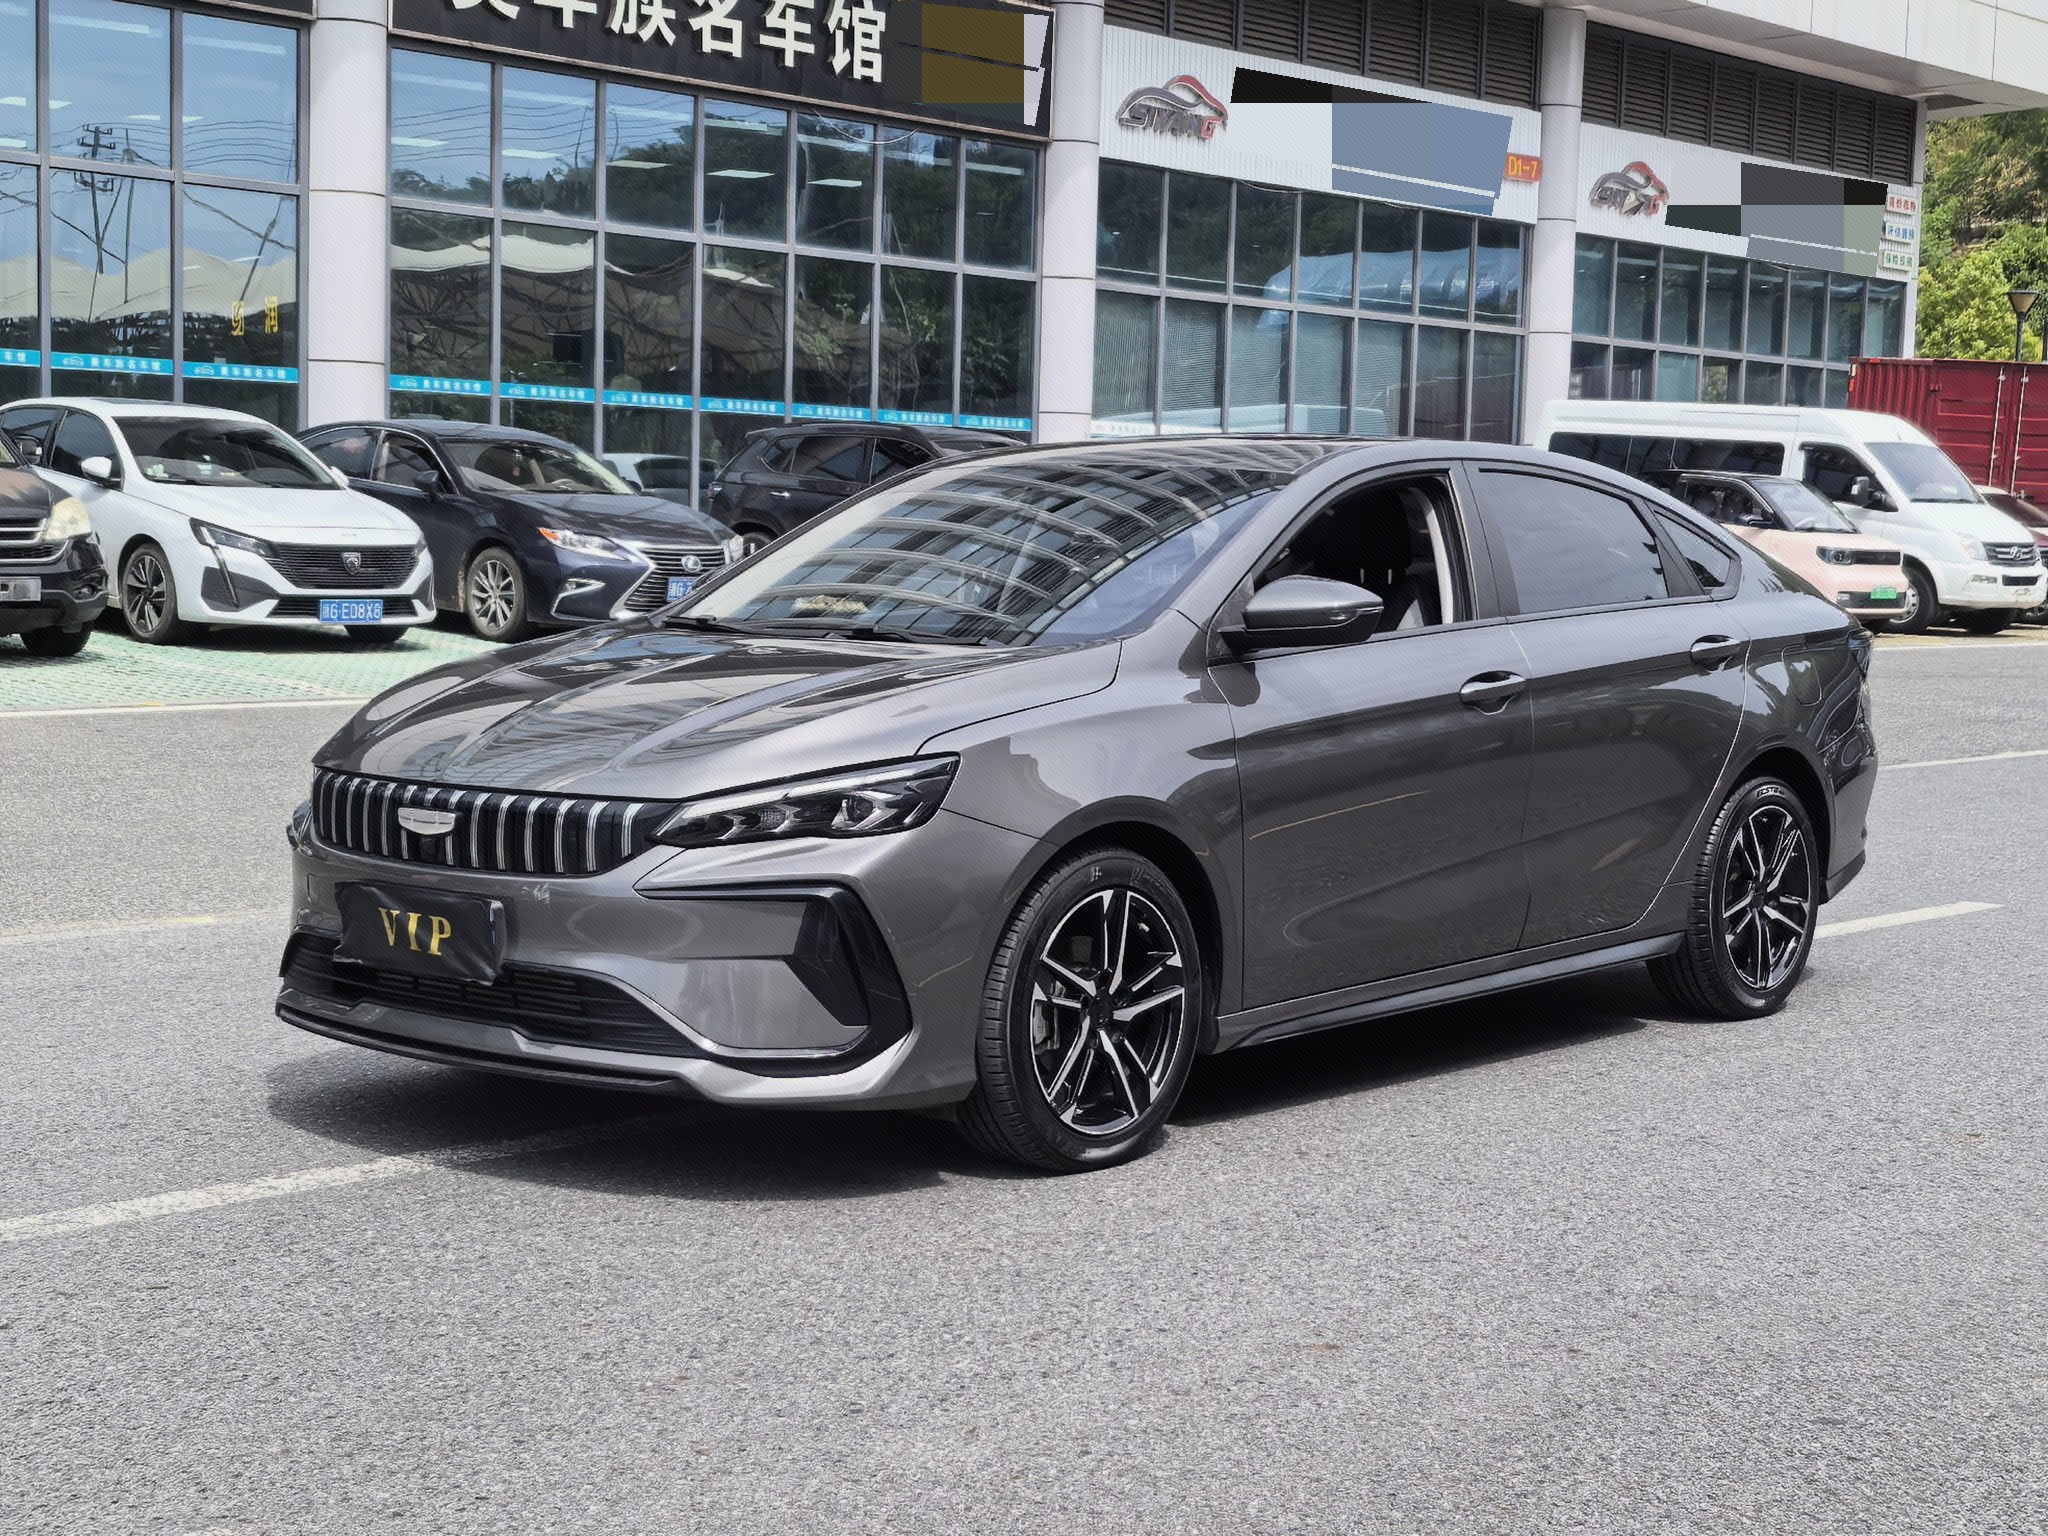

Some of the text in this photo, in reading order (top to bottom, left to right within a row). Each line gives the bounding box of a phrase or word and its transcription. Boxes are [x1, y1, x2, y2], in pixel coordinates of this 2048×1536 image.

[451, 0, 886, 83] 族名车馆
[1508, 155, 1538, 179] D1-7
[378, 907, 452, 956] VIP
